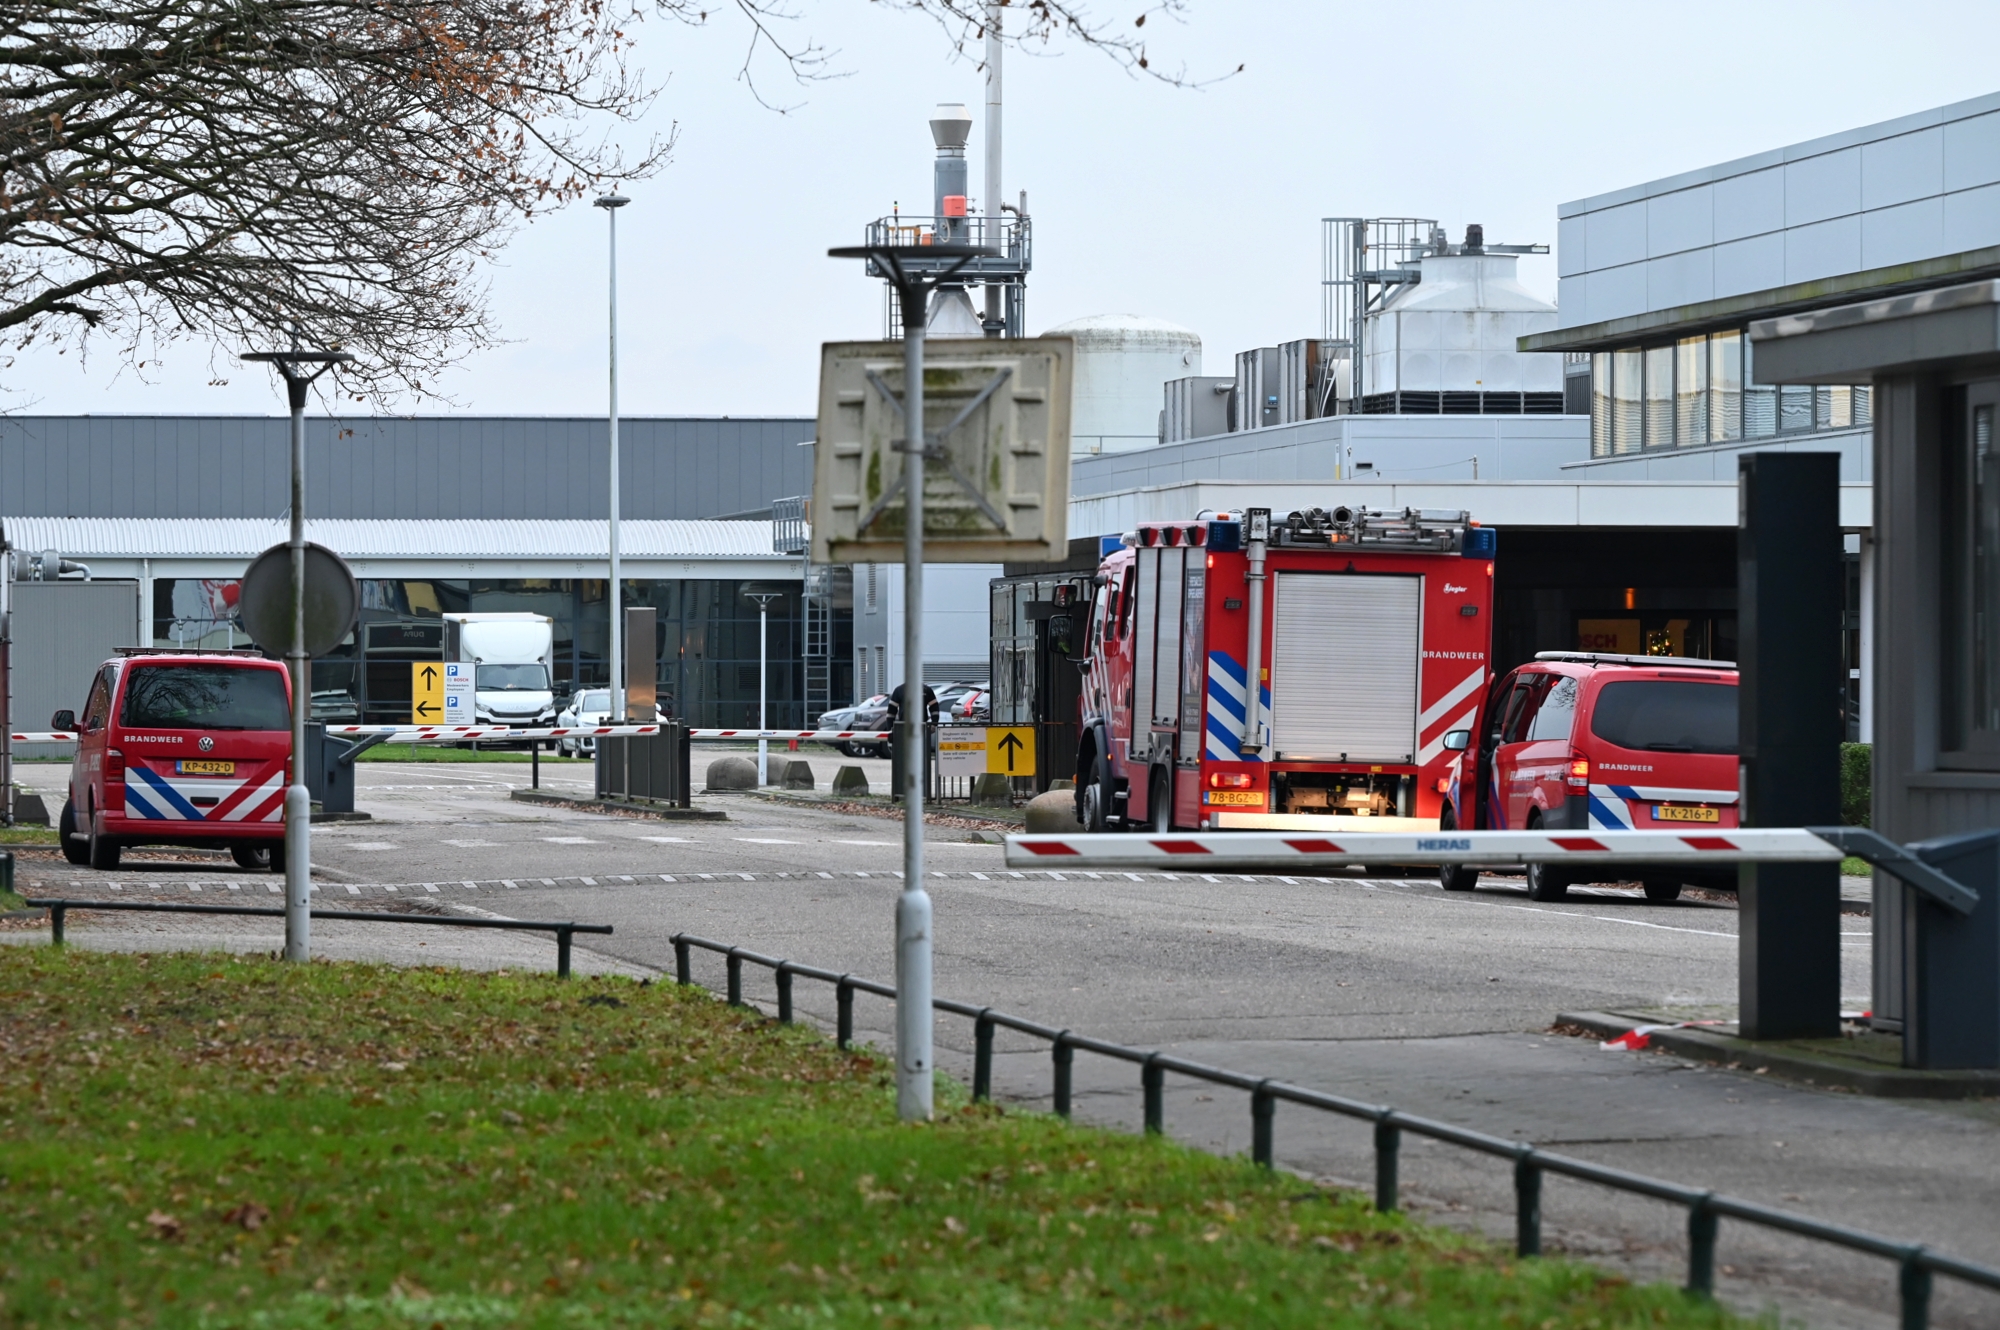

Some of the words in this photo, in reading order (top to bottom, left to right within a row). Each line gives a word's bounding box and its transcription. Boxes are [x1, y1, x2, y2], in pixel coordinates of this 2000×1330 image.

[1443, 583, 1468, 594] Ziegler
[1422, 650, 1485, 660] BRANDWEER
[448, 666, 456, 676] P
[448, 698, 456, 706] P
[124, 736, 183, 744] BRANDWEER
[184, 760, 231, 772] KP-432-D
[1599, 763, 1654, 772] BRANDWEER
[1212, 792, 1258, 804] 78-BGZ-3
[1663, 808, 1713, 820] TK-216-P
[1417, 839, 1471, 850] HERAS
